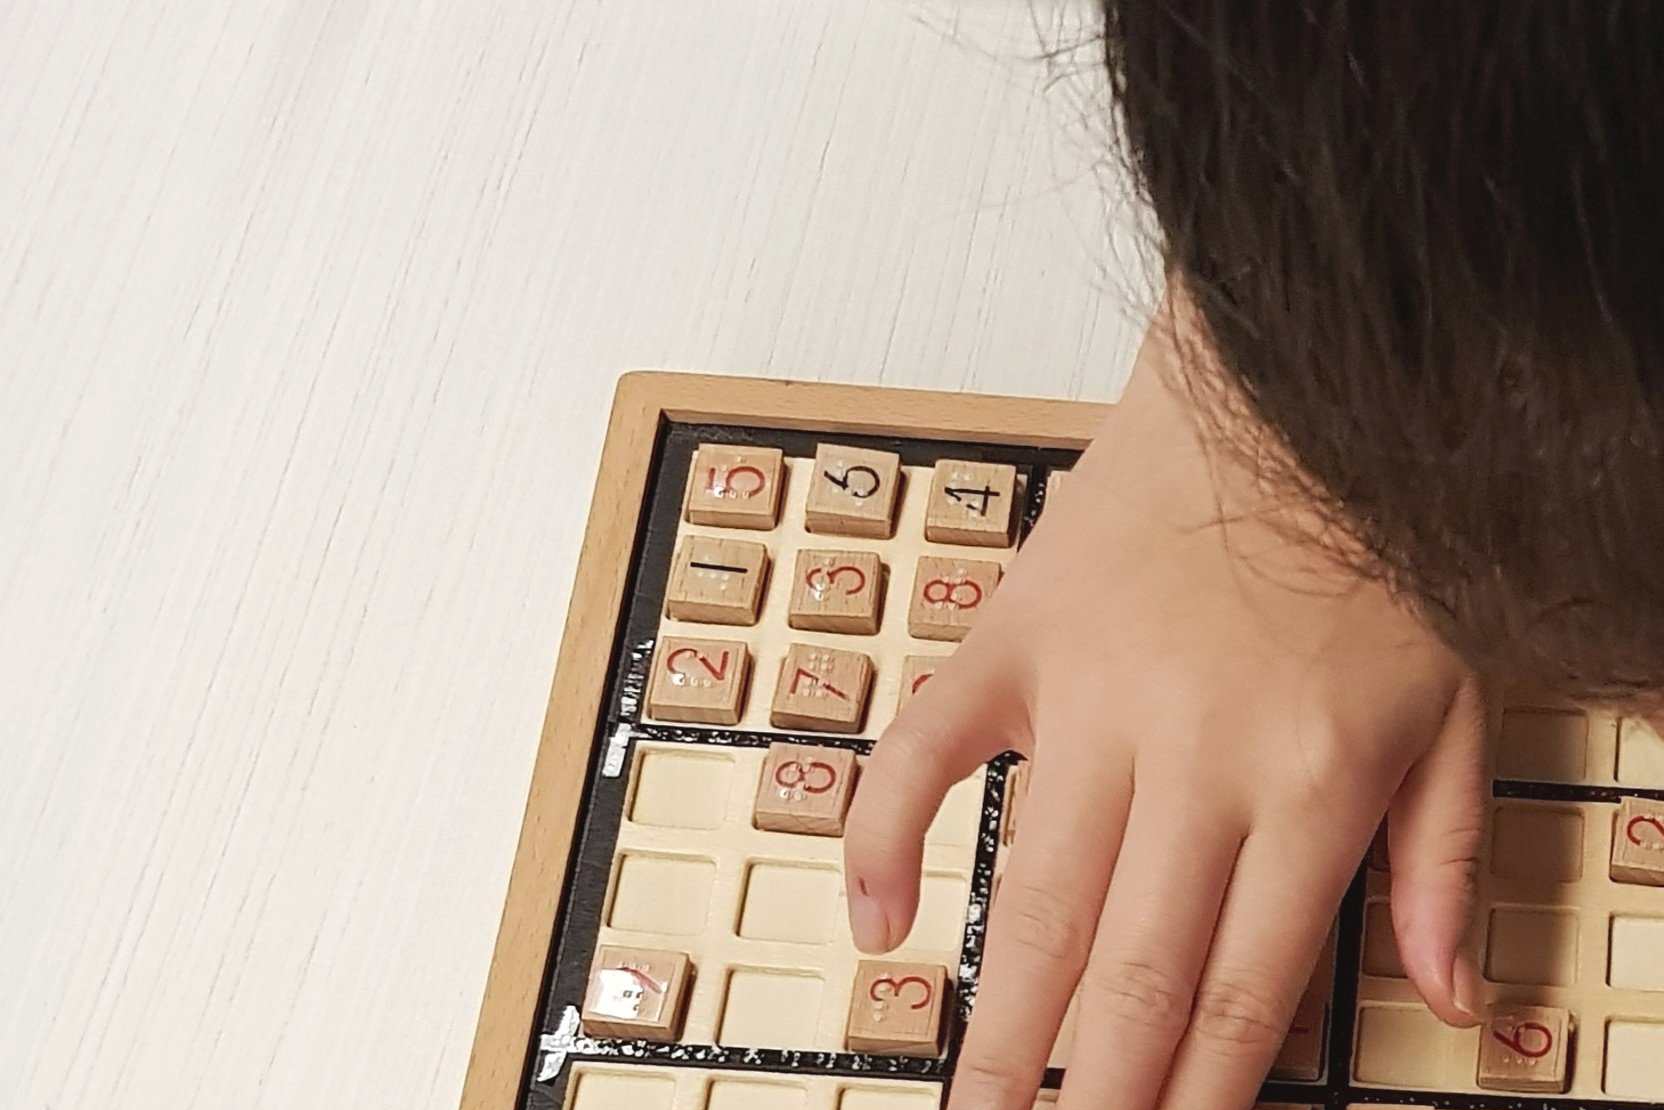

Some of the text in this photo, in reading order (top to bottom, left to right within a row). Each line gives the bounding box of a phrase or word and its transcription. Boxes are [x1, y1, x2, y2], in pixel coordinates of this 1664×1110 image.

[709, 466, 765, 495] 5
[823, 465, 881, 499] 6
[944, 485, 1001, 517] 4
[806, 566, 865, 595] 3
[923, 579, 982, 610] 8
[666, 648, 729, 681] 2
[791, 668, 845, 699] 7
[775, 761, 836, 793] 8
[869, 976, 932, 1010] 3
[1492, 1022, 1552, 1058] 6
